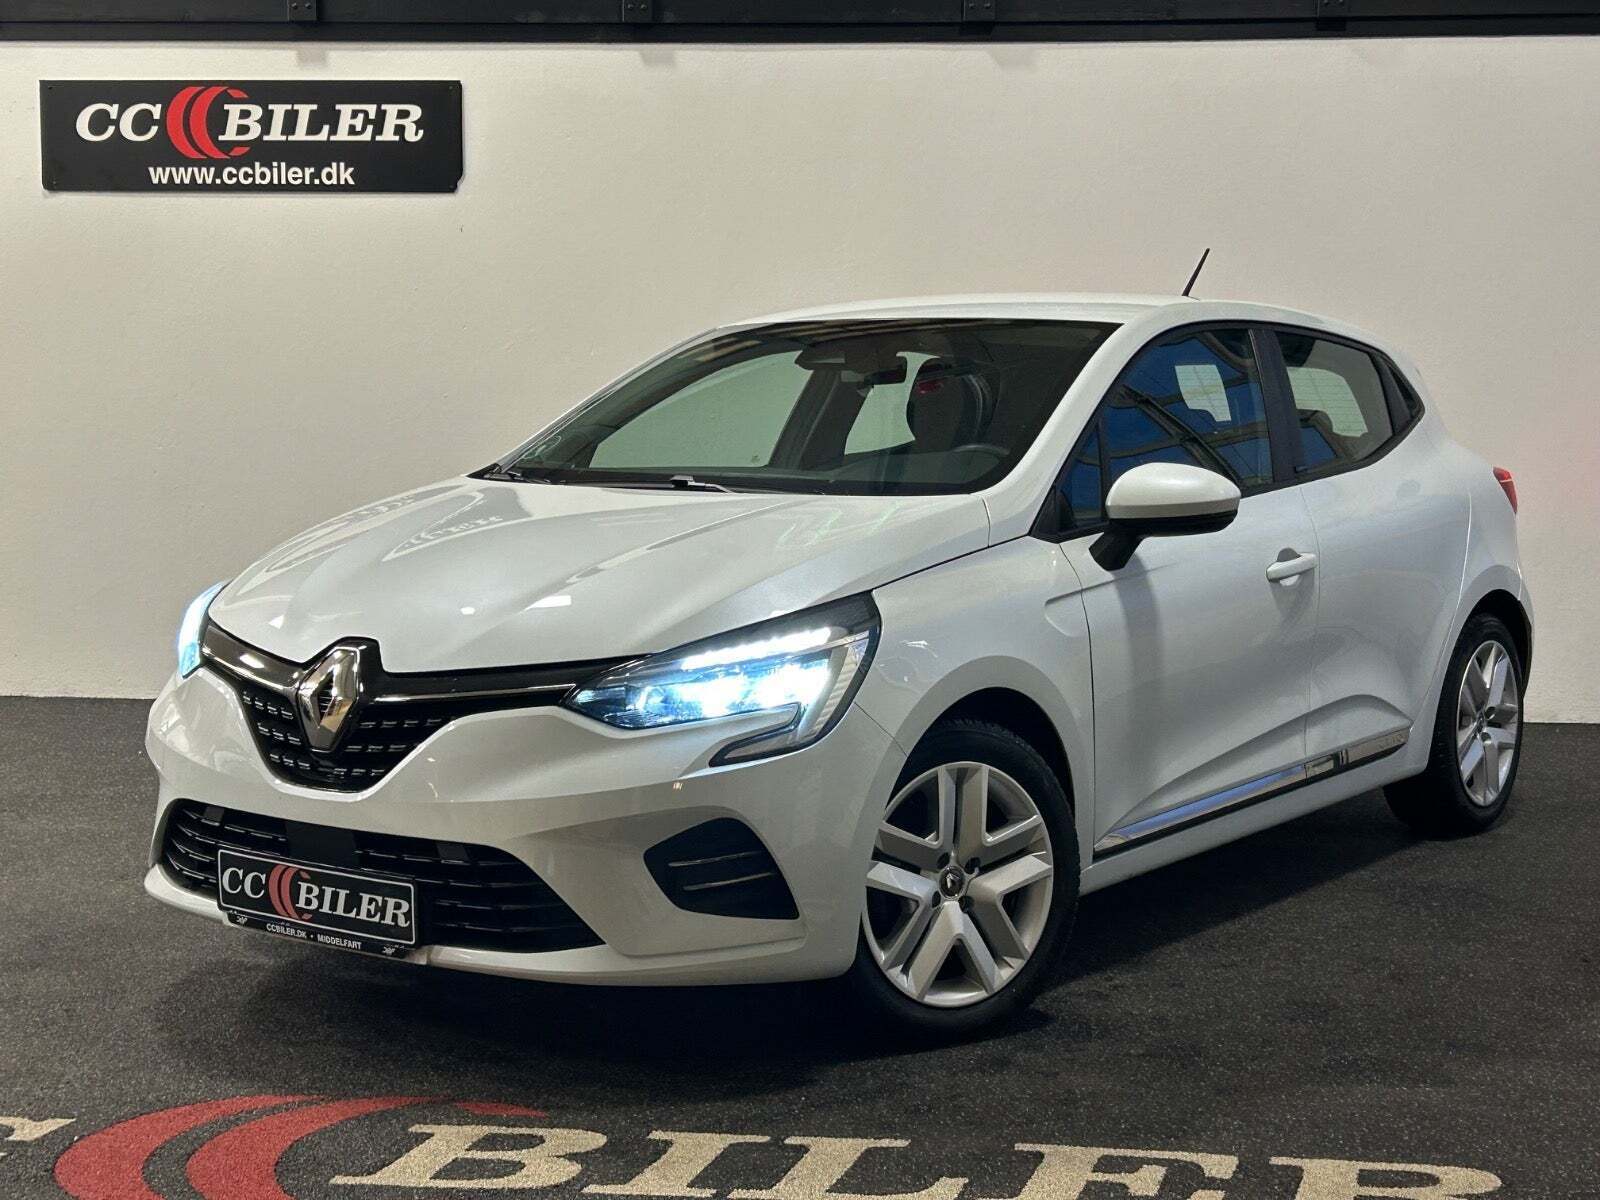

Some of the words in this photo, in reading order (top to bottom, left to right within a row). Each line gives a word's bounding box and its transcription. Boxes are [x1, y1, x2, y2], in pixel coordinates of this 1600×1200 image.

[75, 102, 163, 142] CC
[218, 103, 424, 142] BILER
[148, 162, 355, 186] www.ccbiler.dk
[222, 867, 267, 899] CC
[295, 881, 410, 928] BILER
[266, 923, 307, 939] CCBILER.DK
[317, 933, 362, 950] MIDDELFART
